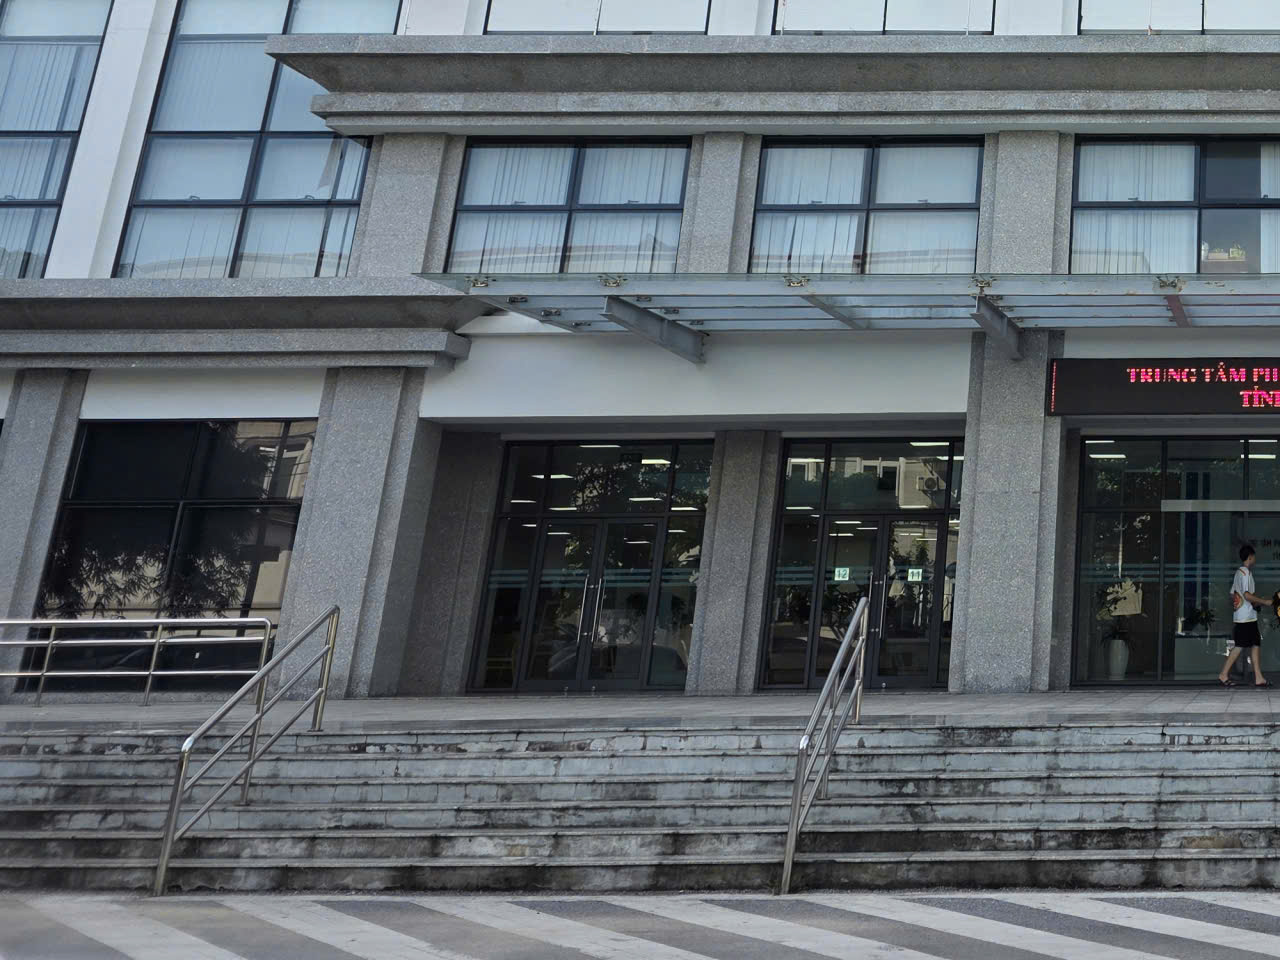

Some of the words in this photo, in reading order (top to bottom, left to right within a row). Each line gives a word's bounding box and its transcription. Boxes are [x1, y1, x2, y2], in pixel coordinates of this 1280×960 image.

[1126, 368, 1197, 383] TRUNG
[1201, 361, 1246, 383] TÂM
[837, 569, 848, 579] 12
[910, 570, 921, 580] 11
